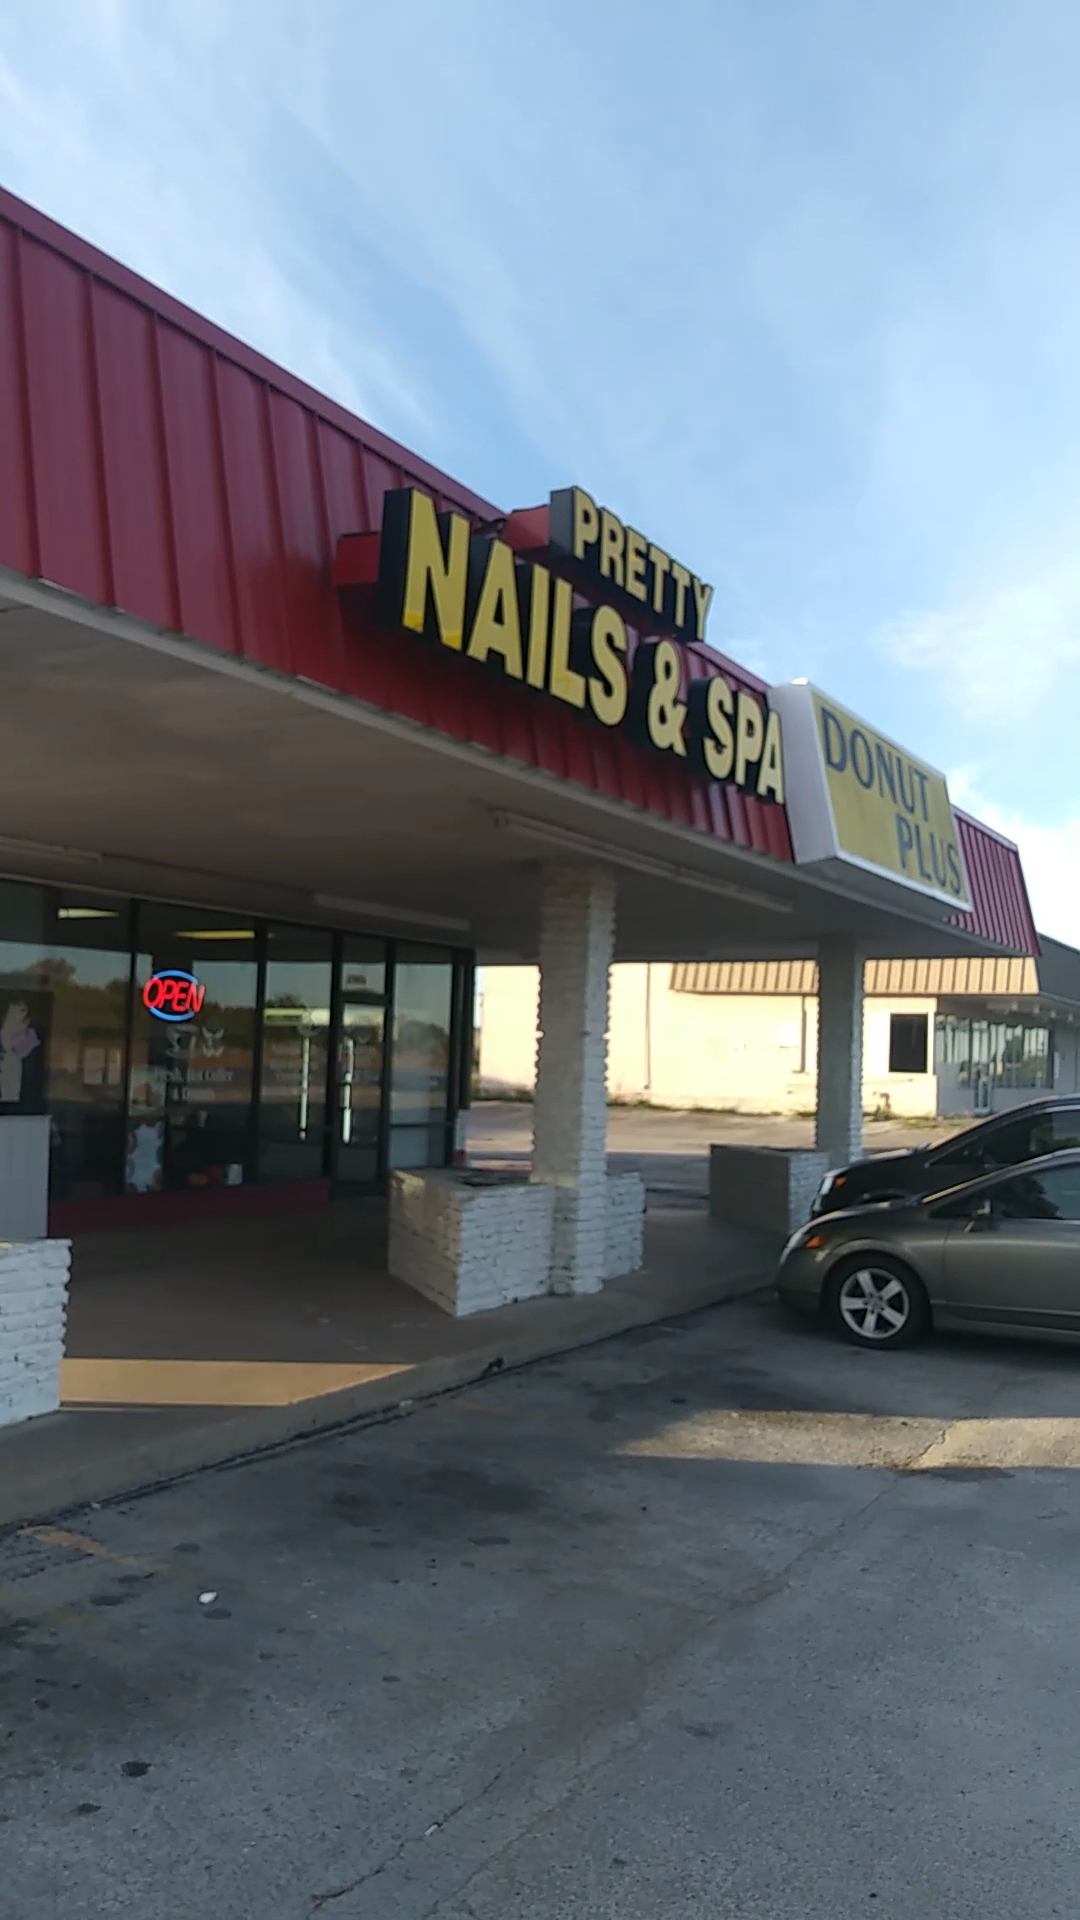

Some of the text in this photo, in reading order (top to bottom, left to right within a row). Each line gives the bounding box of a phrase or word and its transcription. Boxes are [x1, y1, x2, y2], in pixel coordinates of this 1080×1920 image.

[573, 486, 714, 641] PRETTY
[402, 488, 785, 805] NAILS & SPA
[820, 706, 929, 822] DONUT
[895, 812, 962, 895] PLUS
[143, 977, 205, 1013] OPEN
